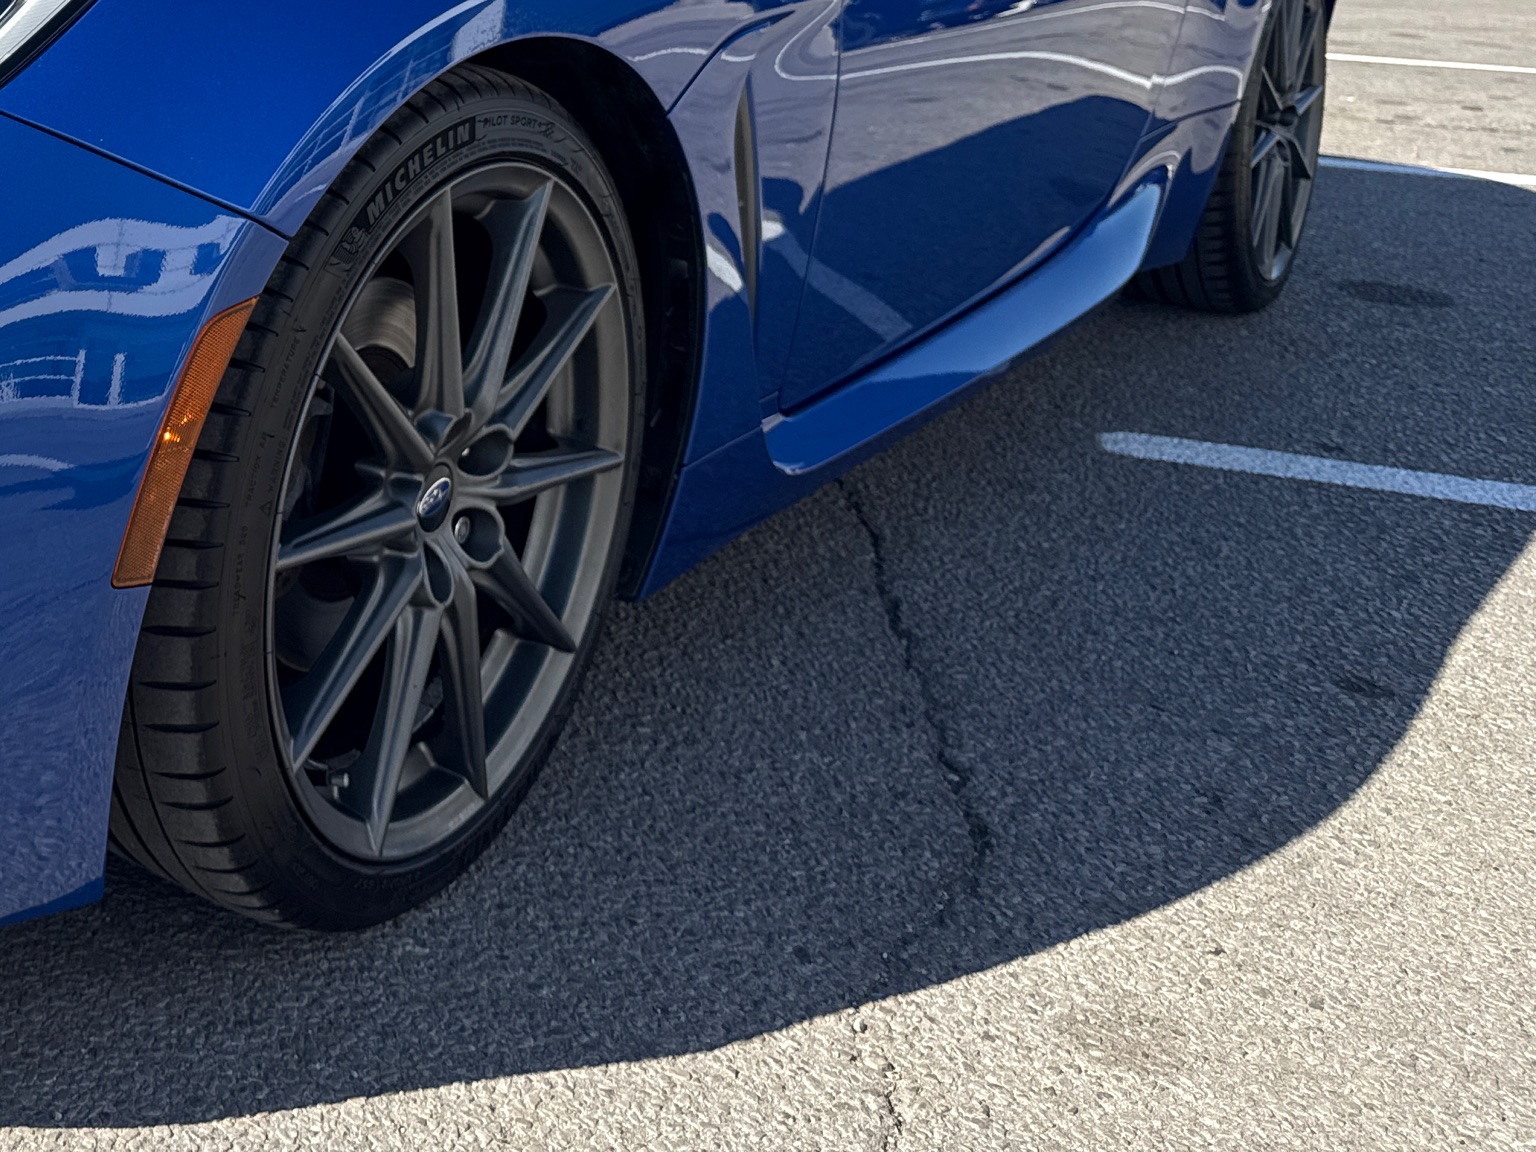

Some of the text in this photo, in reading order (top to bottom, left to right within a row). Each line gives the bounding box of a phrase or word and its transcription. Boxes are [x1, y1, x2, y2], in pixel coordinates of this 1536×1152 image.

[482, 115, 538, 129] PILOT SPORT
[366, 122, 471, 225] MICHELIN
